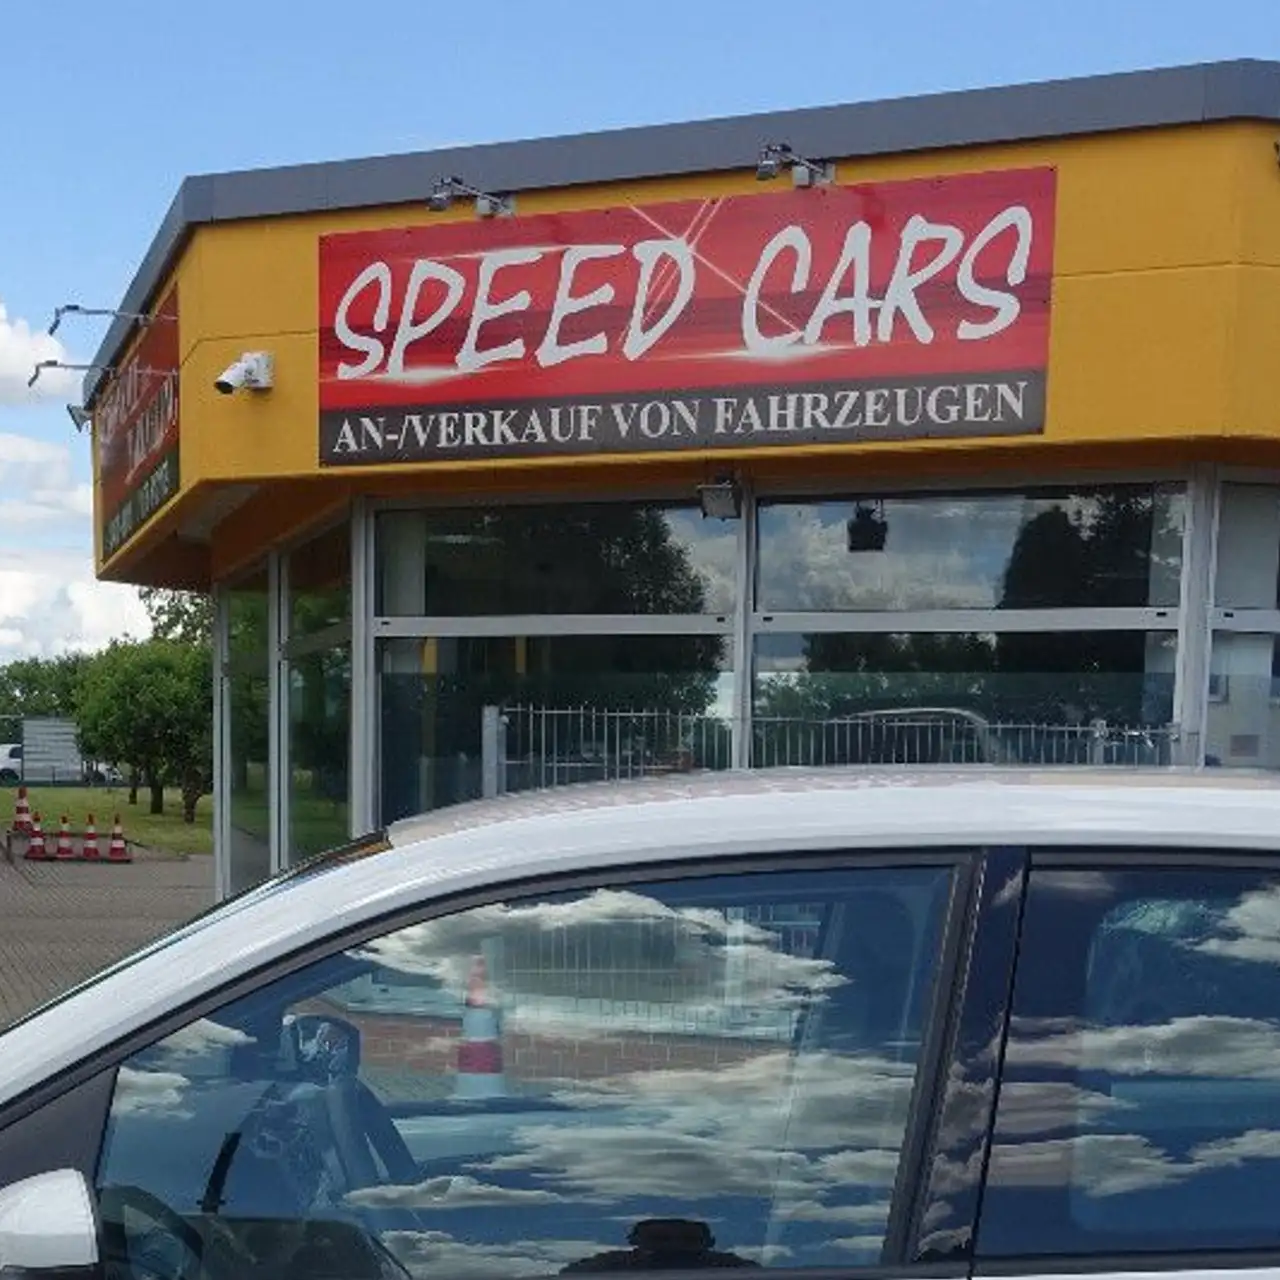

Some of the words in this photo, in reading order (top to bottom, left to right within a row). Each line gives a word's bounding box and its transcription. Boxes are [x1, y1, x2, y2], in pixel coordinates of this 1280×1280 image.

[334, 237, 696, 380] SPEED
[742, 205, 1033, 356] CARS
[332, 404, 603, 453] AN-/VERKAUF
[610, 398, 700, 439] VON
[713, 381, 1028, 434] FAHRZEUGEN
